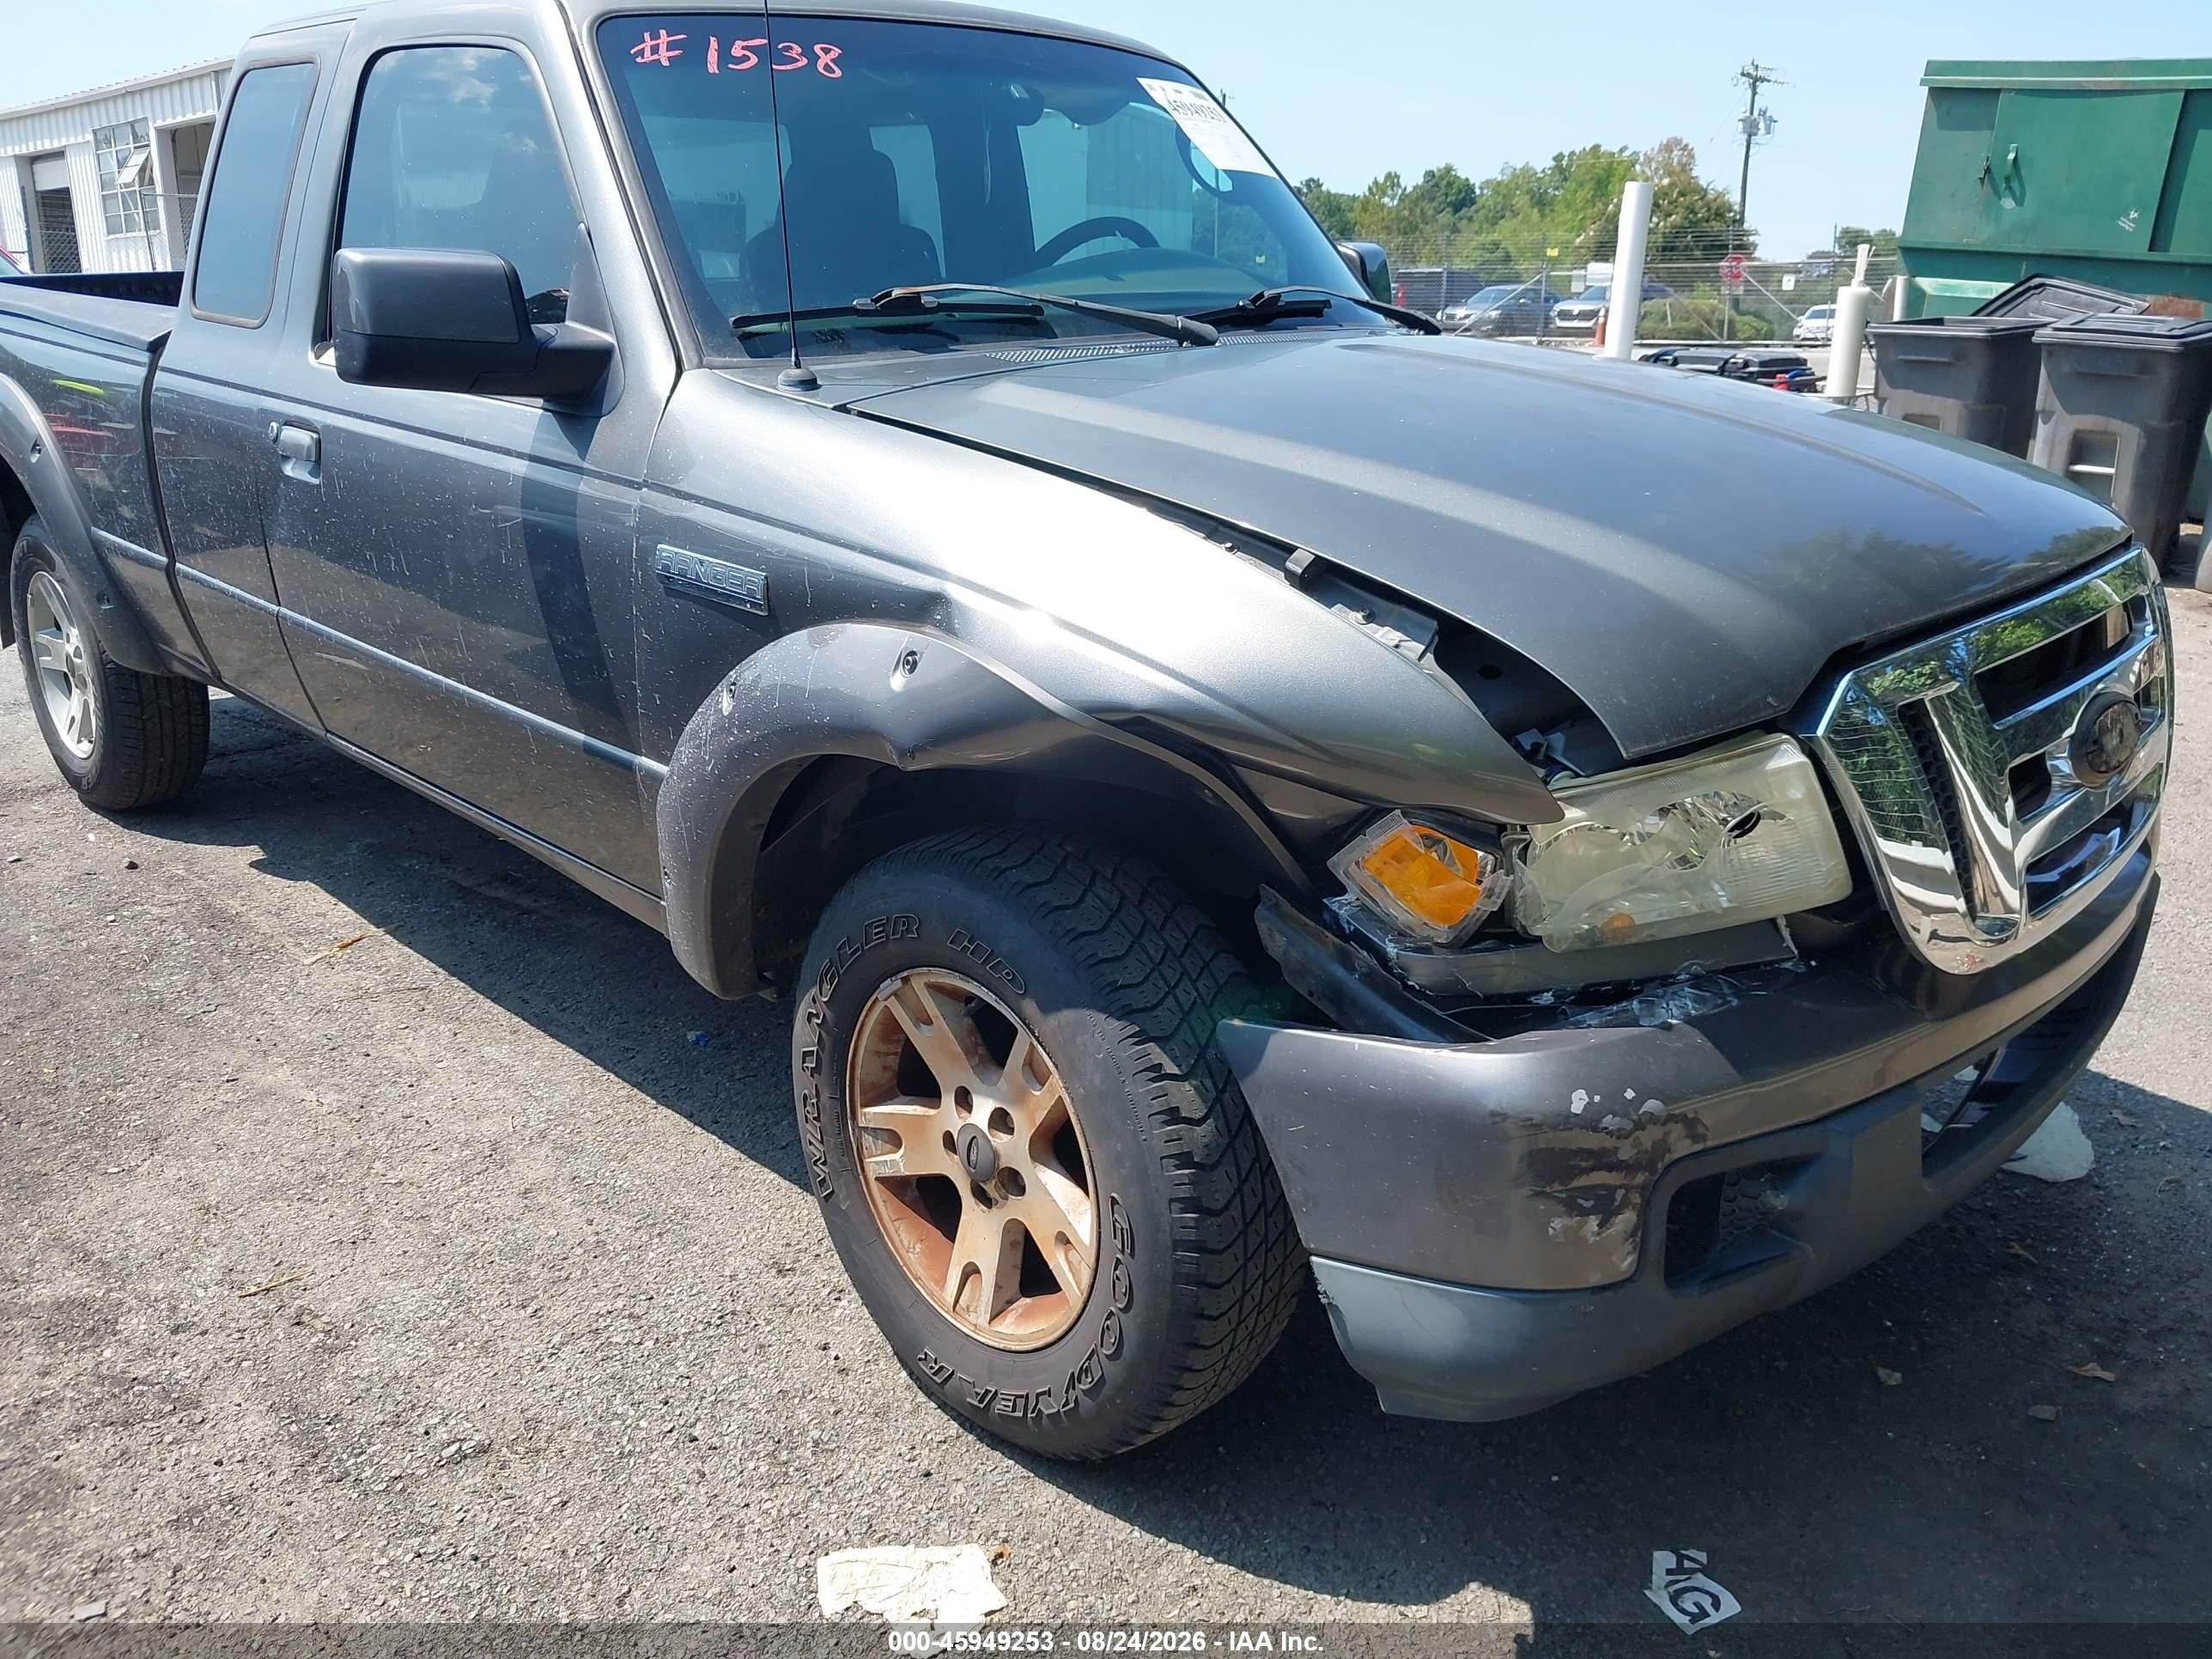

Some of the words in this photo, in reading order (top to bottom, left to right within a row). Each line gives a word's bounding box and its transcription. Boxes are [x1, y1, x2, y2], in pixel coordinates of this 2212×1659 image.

[630, 29, 687, 66] #
[707, 36, 843, 78] 1538
[656, 548, 764, 599] RANGER
[800, 913, 921, 1199] WRANGLER
[947, 927, 1026, 995] HP
[916, 1192, 1133, 1418] GOODYEAR
